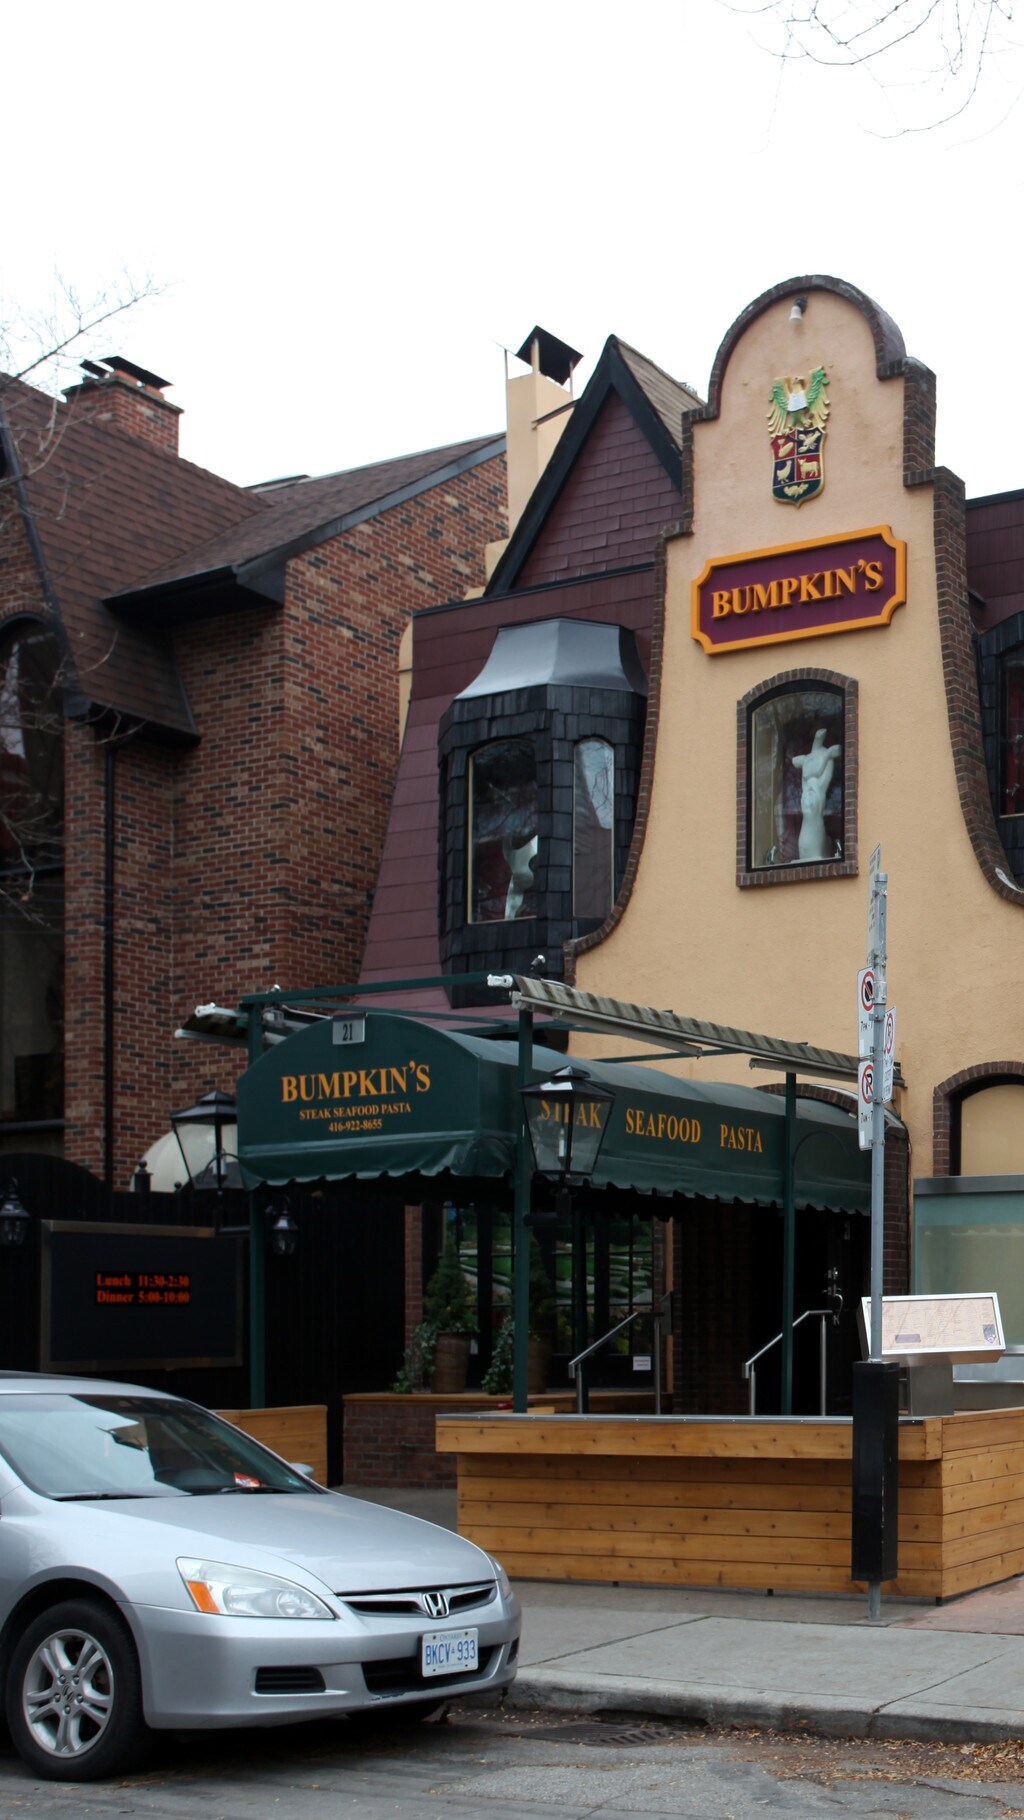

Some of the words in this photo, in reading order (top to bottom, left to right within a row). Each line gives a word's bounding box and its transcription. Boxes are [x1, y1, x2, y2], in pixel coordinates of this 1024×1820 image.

[711, 559, 884, 619] BUMPKIN'S
[342, 1023, 353, 1041] 21
[281, 1060, 431, 1102] BUMPKIN'S
[299, 1108, 331, 1120] STEAK
[333, 1104, 379, 1117] SEAFOOD
[381, 1102, 411, 1114] PASTA
[329, 1118, 382, 1132] 416-922-8655
[625, 1107, 701, 1144] SEAFOOD
[720, 1124, 763, 1153] PASTA
[96, 1273, 131, 1287] Lunch
[138, 1275, 190, 1288] 11:30-2:30
[96, 1290, 134, 1303] Dinner
[425, 1642, 451, 1666] BKCV
[457, 1639, 476, 1661] 933
